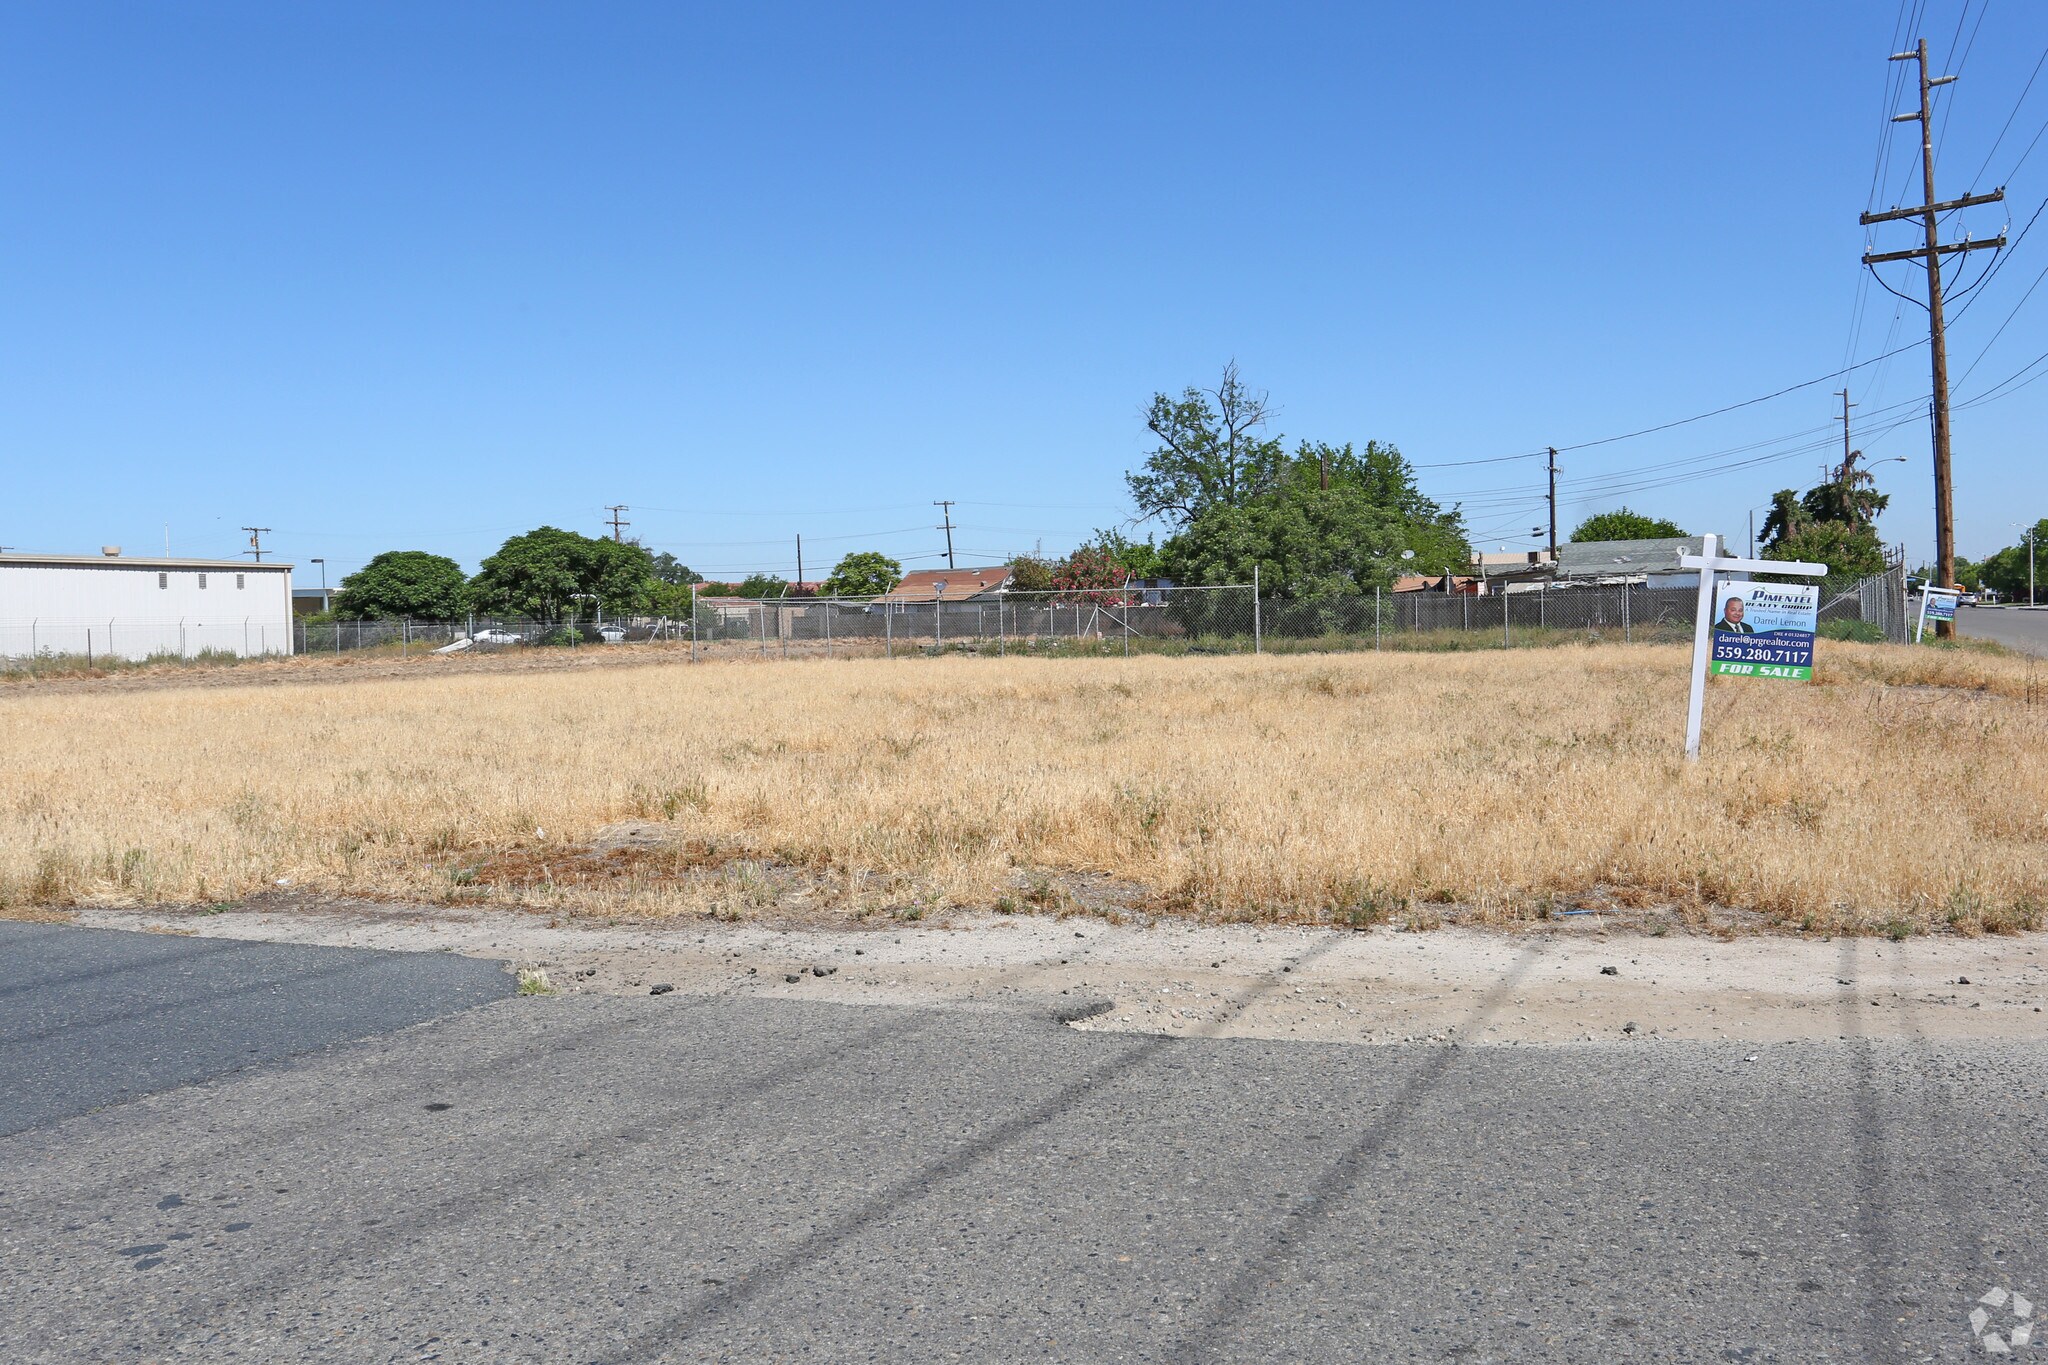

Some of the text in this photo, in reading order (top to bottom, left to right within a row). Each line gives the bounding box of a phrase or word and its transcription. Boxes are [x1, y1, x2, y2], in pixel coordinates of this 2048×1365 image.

[1753, 616, 1807, 627] Darrel Lemon
[1719, 634, 1810, 647] darrel@prgrealtor.com
[1716, 647, 1808, 663] 559.280.7117
[1719, 663, 1804, 678] FOR SALE
